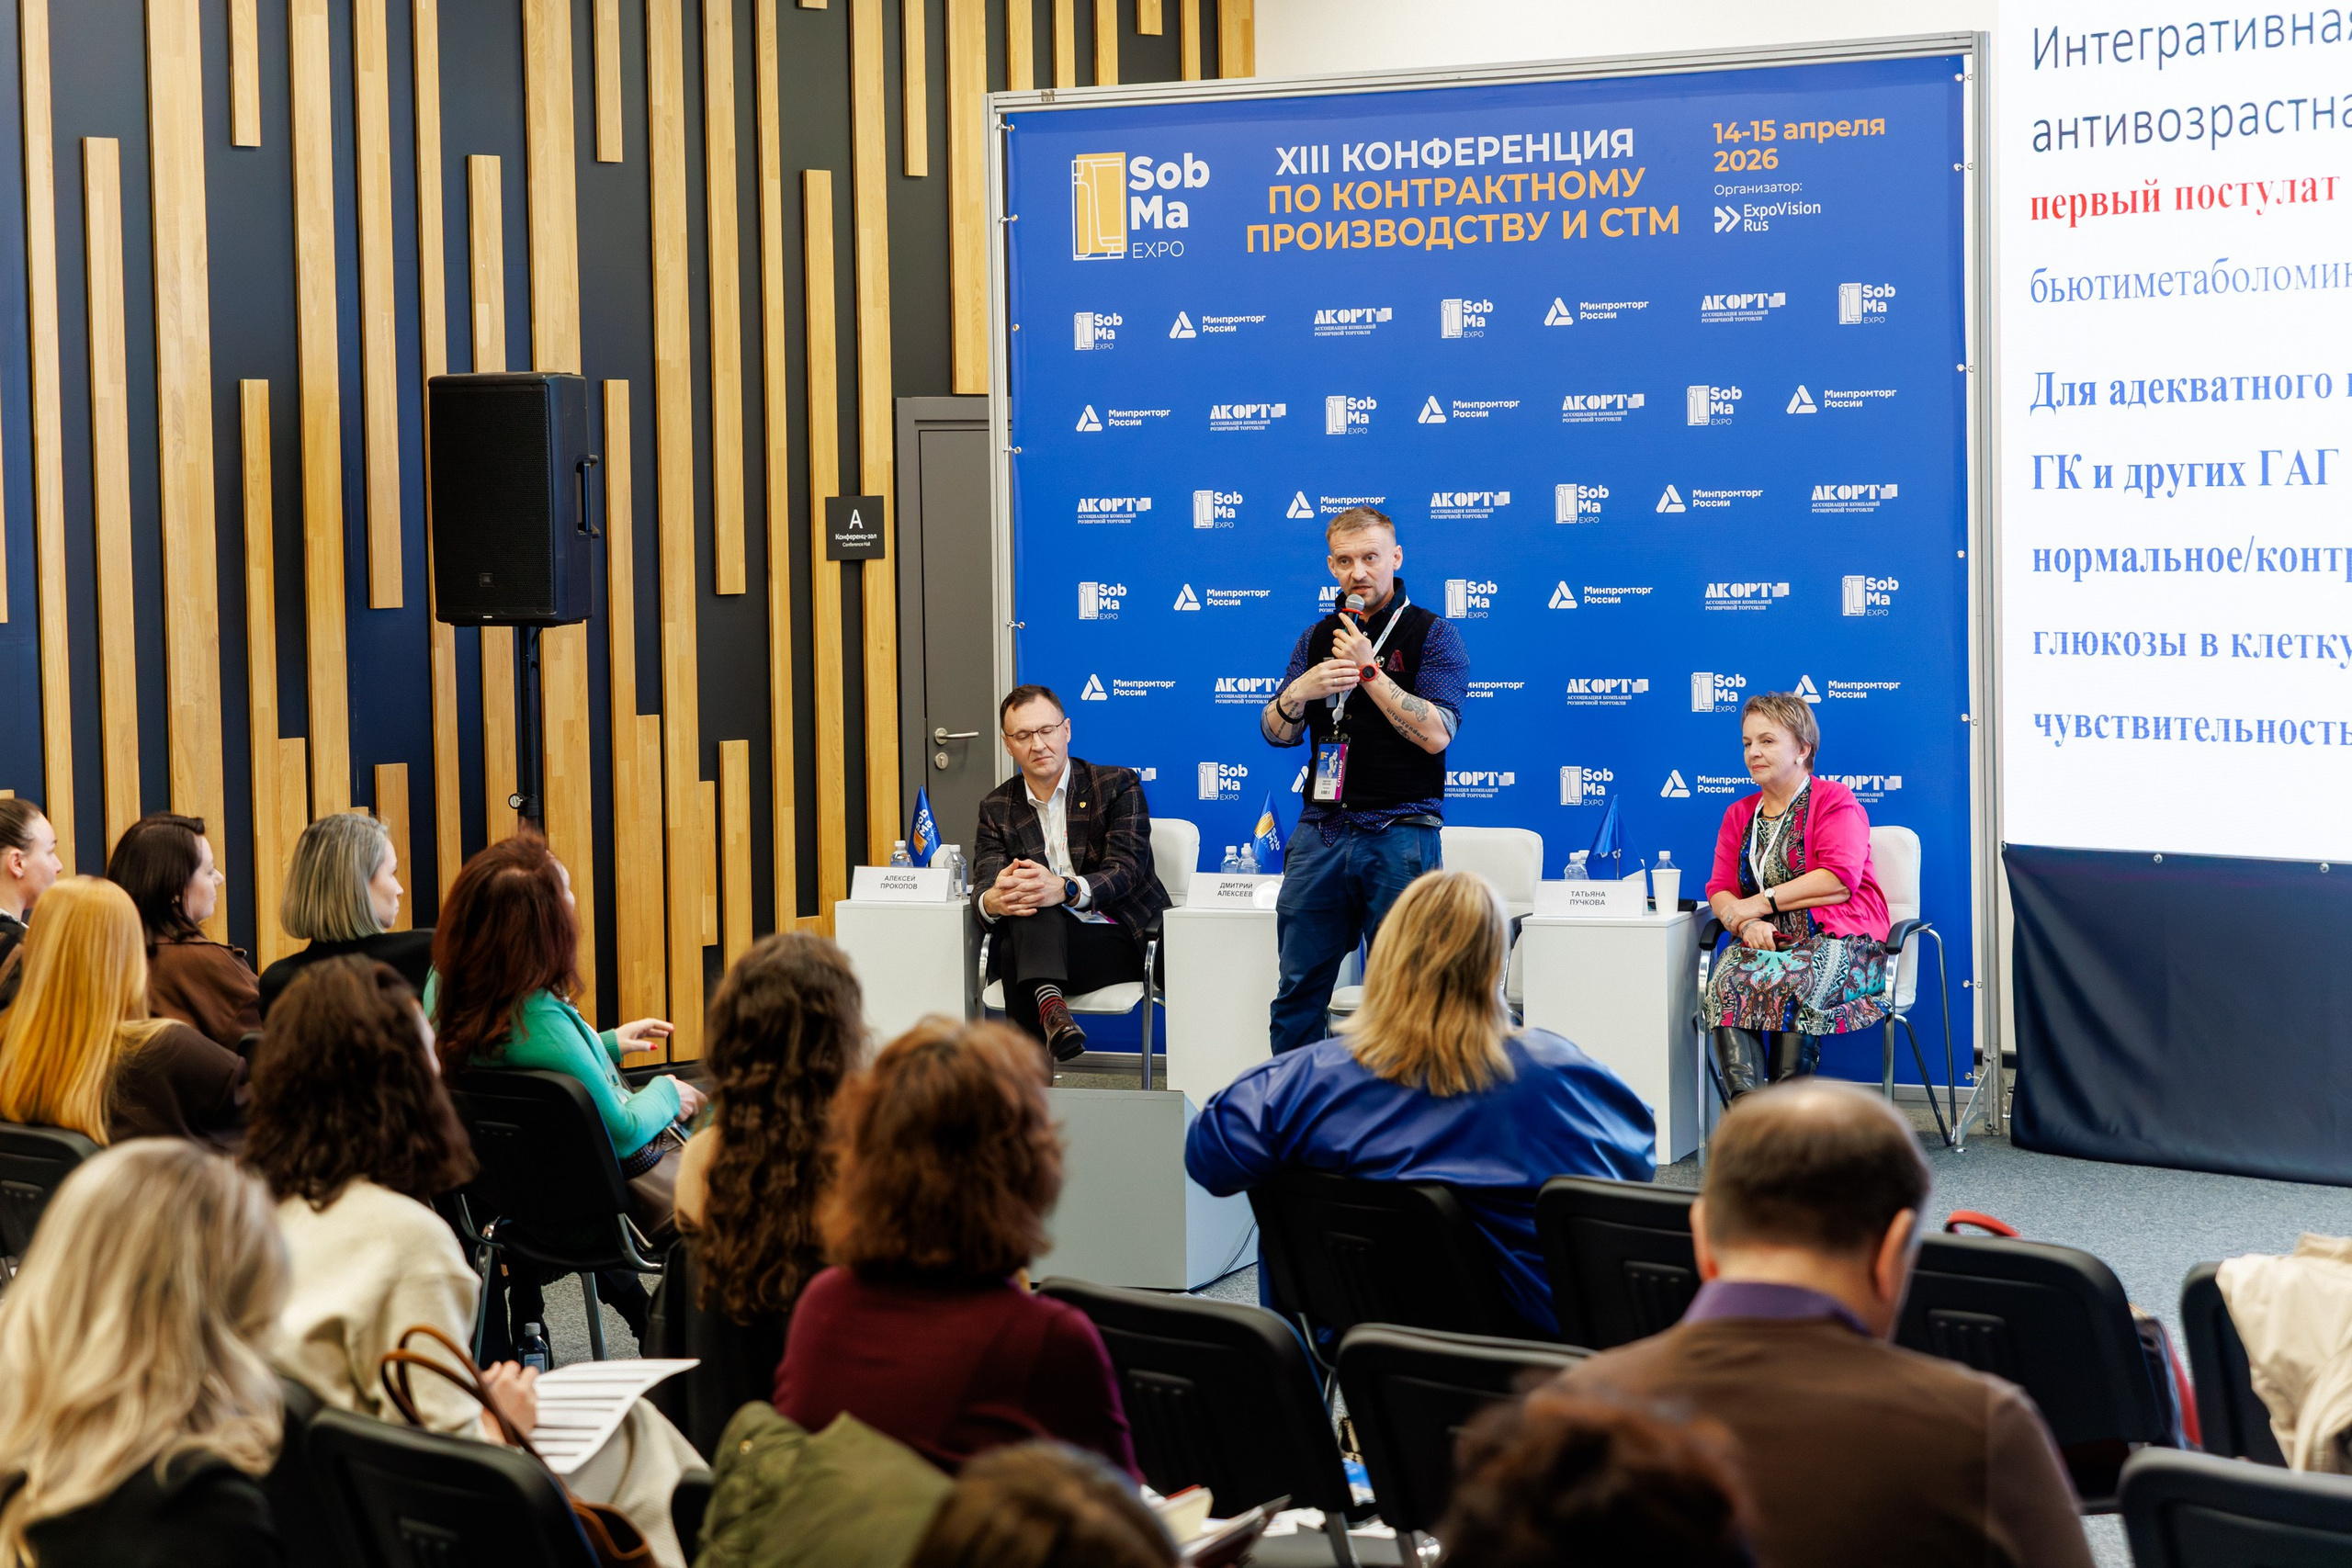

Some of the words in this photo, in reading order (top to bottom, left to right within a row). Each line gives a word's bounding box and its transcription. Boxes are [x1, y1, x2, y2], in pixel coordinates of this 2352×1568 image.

[2033, 8, 2352, 71] Интегративна
[1713, 119, 1777, 144] 14-15
[1783, 118, 1885, 144] апреля
[1275, 144, 1329, 175] XIII
[1342, 128, 1634, 172] КОНФЕРЕНЦИЯ
[1713, 147, 1779, 173] 2026
[1128, 152, 1210, 191] Sob
[1269, 183, 1321, 214] ПО
[1332, 166, 1646, 211] КОНТРАКТНОМУ
[1714, 182, 1803, 197] Организатор:
[2031, 178, 2161, 229] первый
[2176, 176, 2340, 216] постулат
[1130, 195, 1189, 231] Ma
[1744, 200, 1821, 220] ExpoVision
[1247, 211, 1551, 254] ПРОИЗВОДСТВУ
[1563, 209, 1587, 240] И
[1600, 205, 1679, 238] СТМ
[1744, 218, 1770, 232] Rus
[1133, 240, 1184, 259] EXPO
[1862, 283, 1895, 299] Sob
[1463, 299, 1493, 313] Sob
[1580, 301, 1649, 311] Минпромторг
[1701, 293, 1769, 310] АКОРТ
[1863, 299, 1887, 313] Ma
[1094, 312, 1123, 326] Sob
[1203, 315, 1266, 324] Минпромторг
[1314, 308, 1376, 324] АКОРТ
[1464, 314, 1486, 328] Ma
[1580, 311, 1617, 320] России
[1863, 316, 1885, 324] EXPO
[1094, 327, 1115, 340] Ma
[1710, 386, 1742, 400] Sob
[1825, 389, 1897, 400] Минпромторг
[2030, 371, 2097, 415] Для
[2109, 373, 2333, 410] адекватного
[1347, 396, 1377, 411] Sob
[1453, 400, 1520, 410] Минпромторг
[1562, 394, 1627, 411] АКОРТ
[1711, 401, 1734, 414] Ma
[1825, 400, 1862, 408] России
[1108, 410, 1170, 418] Минпромторг
[1210, 404, 1271, 420] АКОРТ
[1347, 411, 1369, 424] Ma
[1453, 410, 1488, 418] России
[1109, 418, 1142, 426] России
[2032, 453, 2083, 490] ГК
[2094, 465, 2113, 489] и
[2124, 462, 2246, 499] других
[2259, 448, 2340, 487] ГАГ
[1214, 491, 1243, 504] Sob
[1577, 485, 1609, 499] Sob
[1692, 490, 1763, 499] Минпромторг
[1811, 484, 1880, 501] АКОРТ
[1077, 498, 1136, 513] АКОРТ
[1320, 496, 1385, 505] Минпромторг
[1430, 491, 1494, 507] АКОРТ
[1693, 499, 1730, 507] России
[1215, 505, 1236, 518] Ma
[1578, 500, 1601, 513] Ma
[835, 533, 877, 541] Конференц-зал
[1098, 583, 1127, 596] Sob
[1467, 581, 1498, 594] Sob
[1705, 582, 1772, 598] АКОРТ
[1866, 577, 1899, 591] Sob
[1206, 589, 1271, 598] Минпромторг
[1584, 586, 1653, 596] Минпромторг
[1099, 597, 1120, 610] Ma
[1207, 598, 1241, 606] России
[1467, 595, 1490, 608] Ma
[1584, 595, 1621, 604] России
[1866, 592, 1890, 605] Ma
[2033, 631, 2187, 658] глюкозы
[2199, 633, 2219, 658] в
[2232, 632, 2352, 670] клетку
[1114, 679, 1176, 689] Минпромторг
[1215, 678, 1275, 692] АКОРТ
[1468, 682, 1525, 690] инпромторг
[1566, 679, 1632, 694] АКОРТ
[1714, 673, 1747, 687] Sob
[1828, 681, 1901, 691] Минпромторг
[1114, 688, 1147, 696] России
[1714, 688, 1738, 702] Ma
[1828, 690, 1867, 698] России
[2034, 713, 2352, 748] чувствительность
[1219, 764, 1248, 777] Sob
[1582, 768, 1613, 782] Sob
[1219, 778, 1240, 791] Ma
[1698, 775, 1758, 785] Минпромто
[1583, 783, 1605, 795] Ma
[1698, 784, 1735, 794] России
